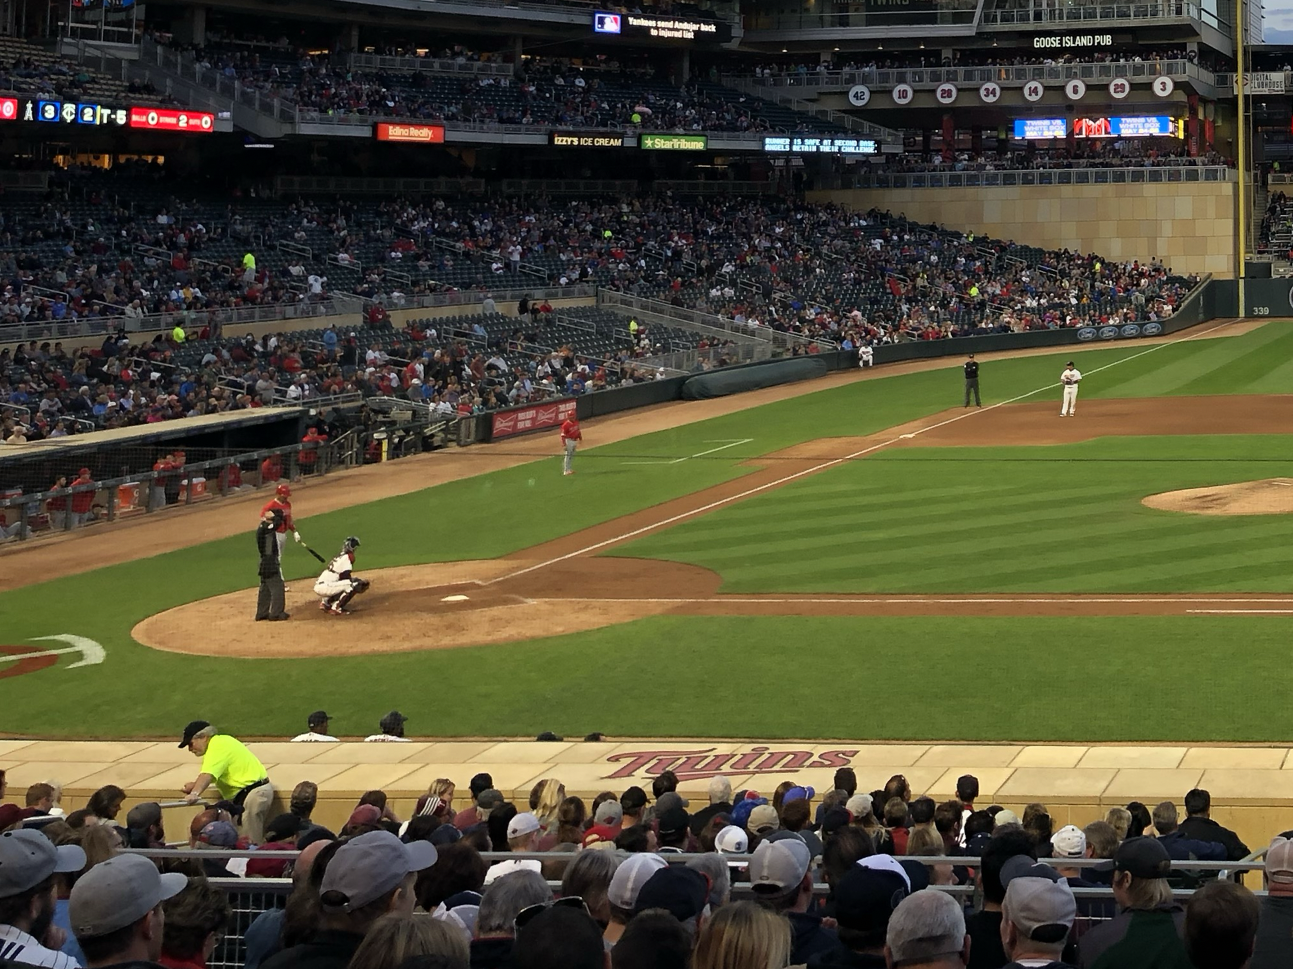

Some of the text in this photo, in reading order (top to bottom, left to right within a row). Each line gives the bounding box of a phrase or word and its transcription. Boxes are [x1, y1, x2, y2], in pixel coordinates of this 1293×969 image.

[628, 17, 716, 32] Yankees send Andujar back
[1034, 34, 1112, 48] GOOSE ISLAND PUB
[853, 86, 1038, 100] 42 10 34 14
[389, 126, 432, 139] Edina Realty
[580, 137, 592, 146] ICE
[594, 137, 621, 147] CREAM
[654, 138, 704, 150] StarTribune
[1253, 306, 1270, 315] 339
[601, 746, 860, 782] Twins
